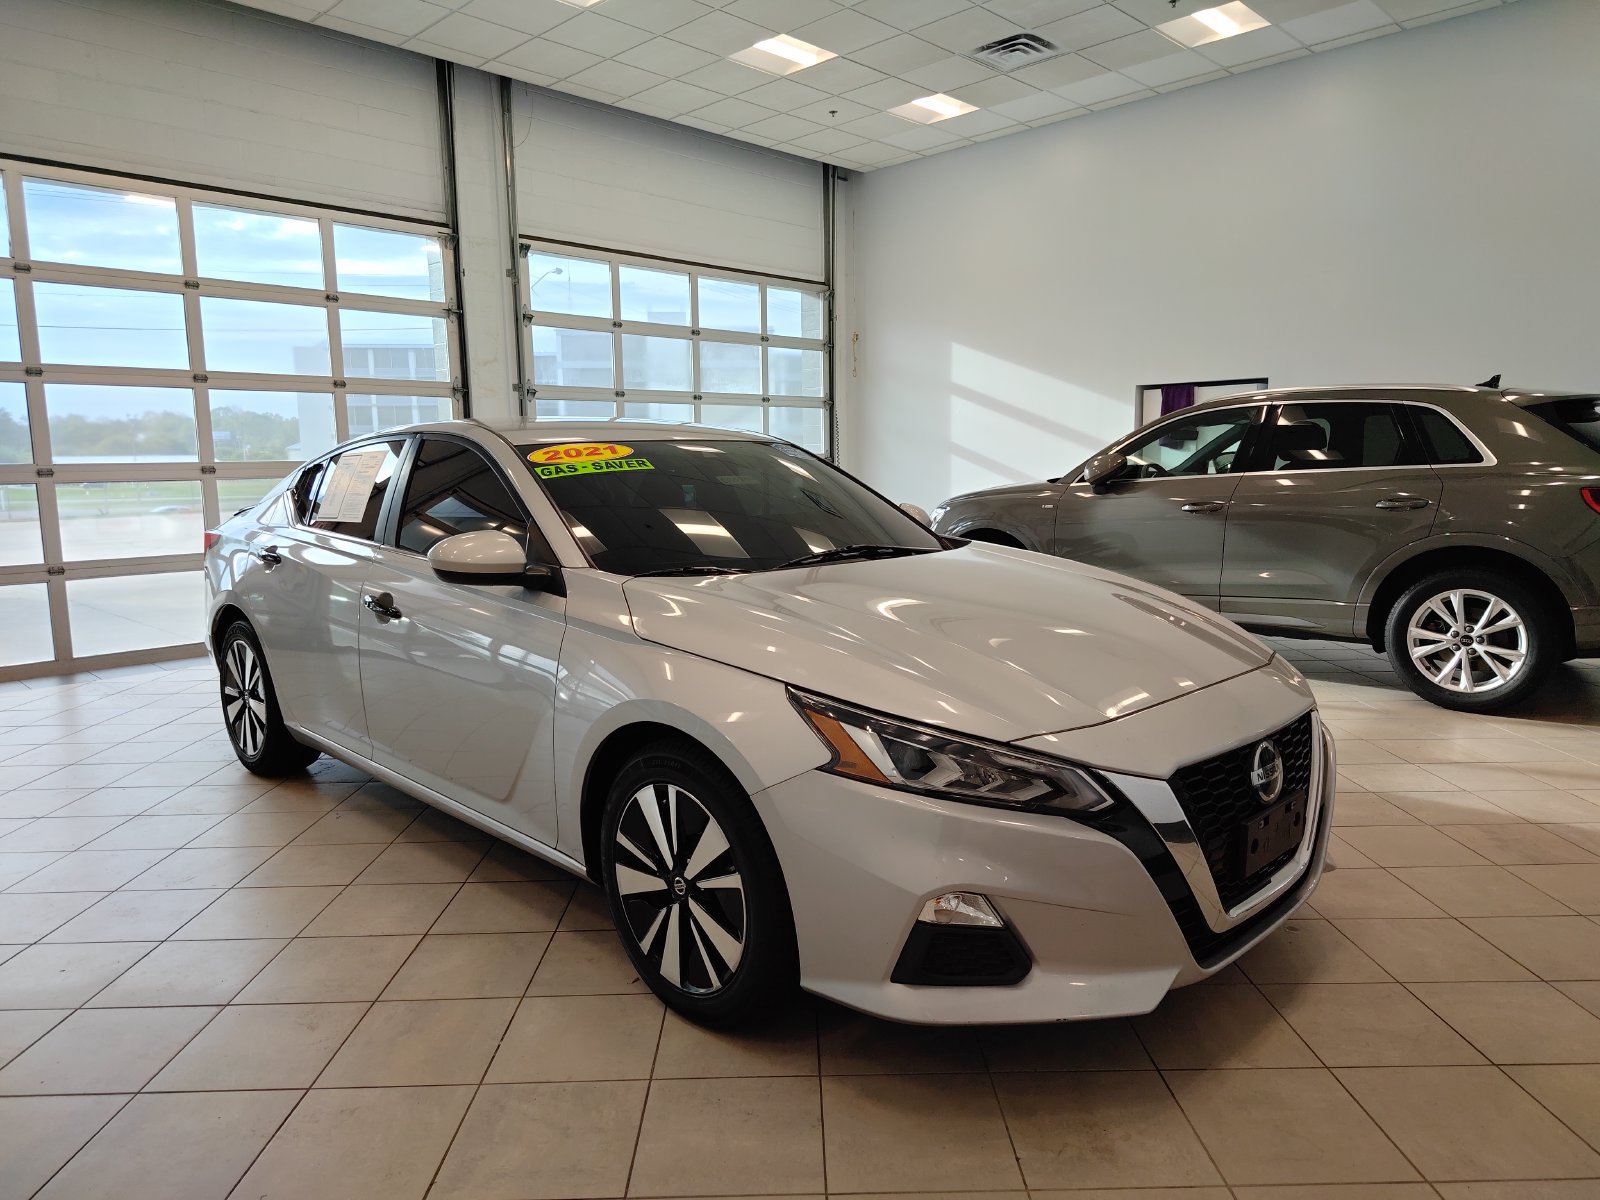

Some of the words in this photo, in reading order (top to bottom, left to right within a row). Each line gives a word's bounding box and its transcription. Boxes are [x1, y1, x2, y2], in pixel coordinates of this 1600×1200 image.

[543, 445, 618, 461] 2021
[541, 464, 578, 476] GAS
[592, 459, 649, 470] SAVER
